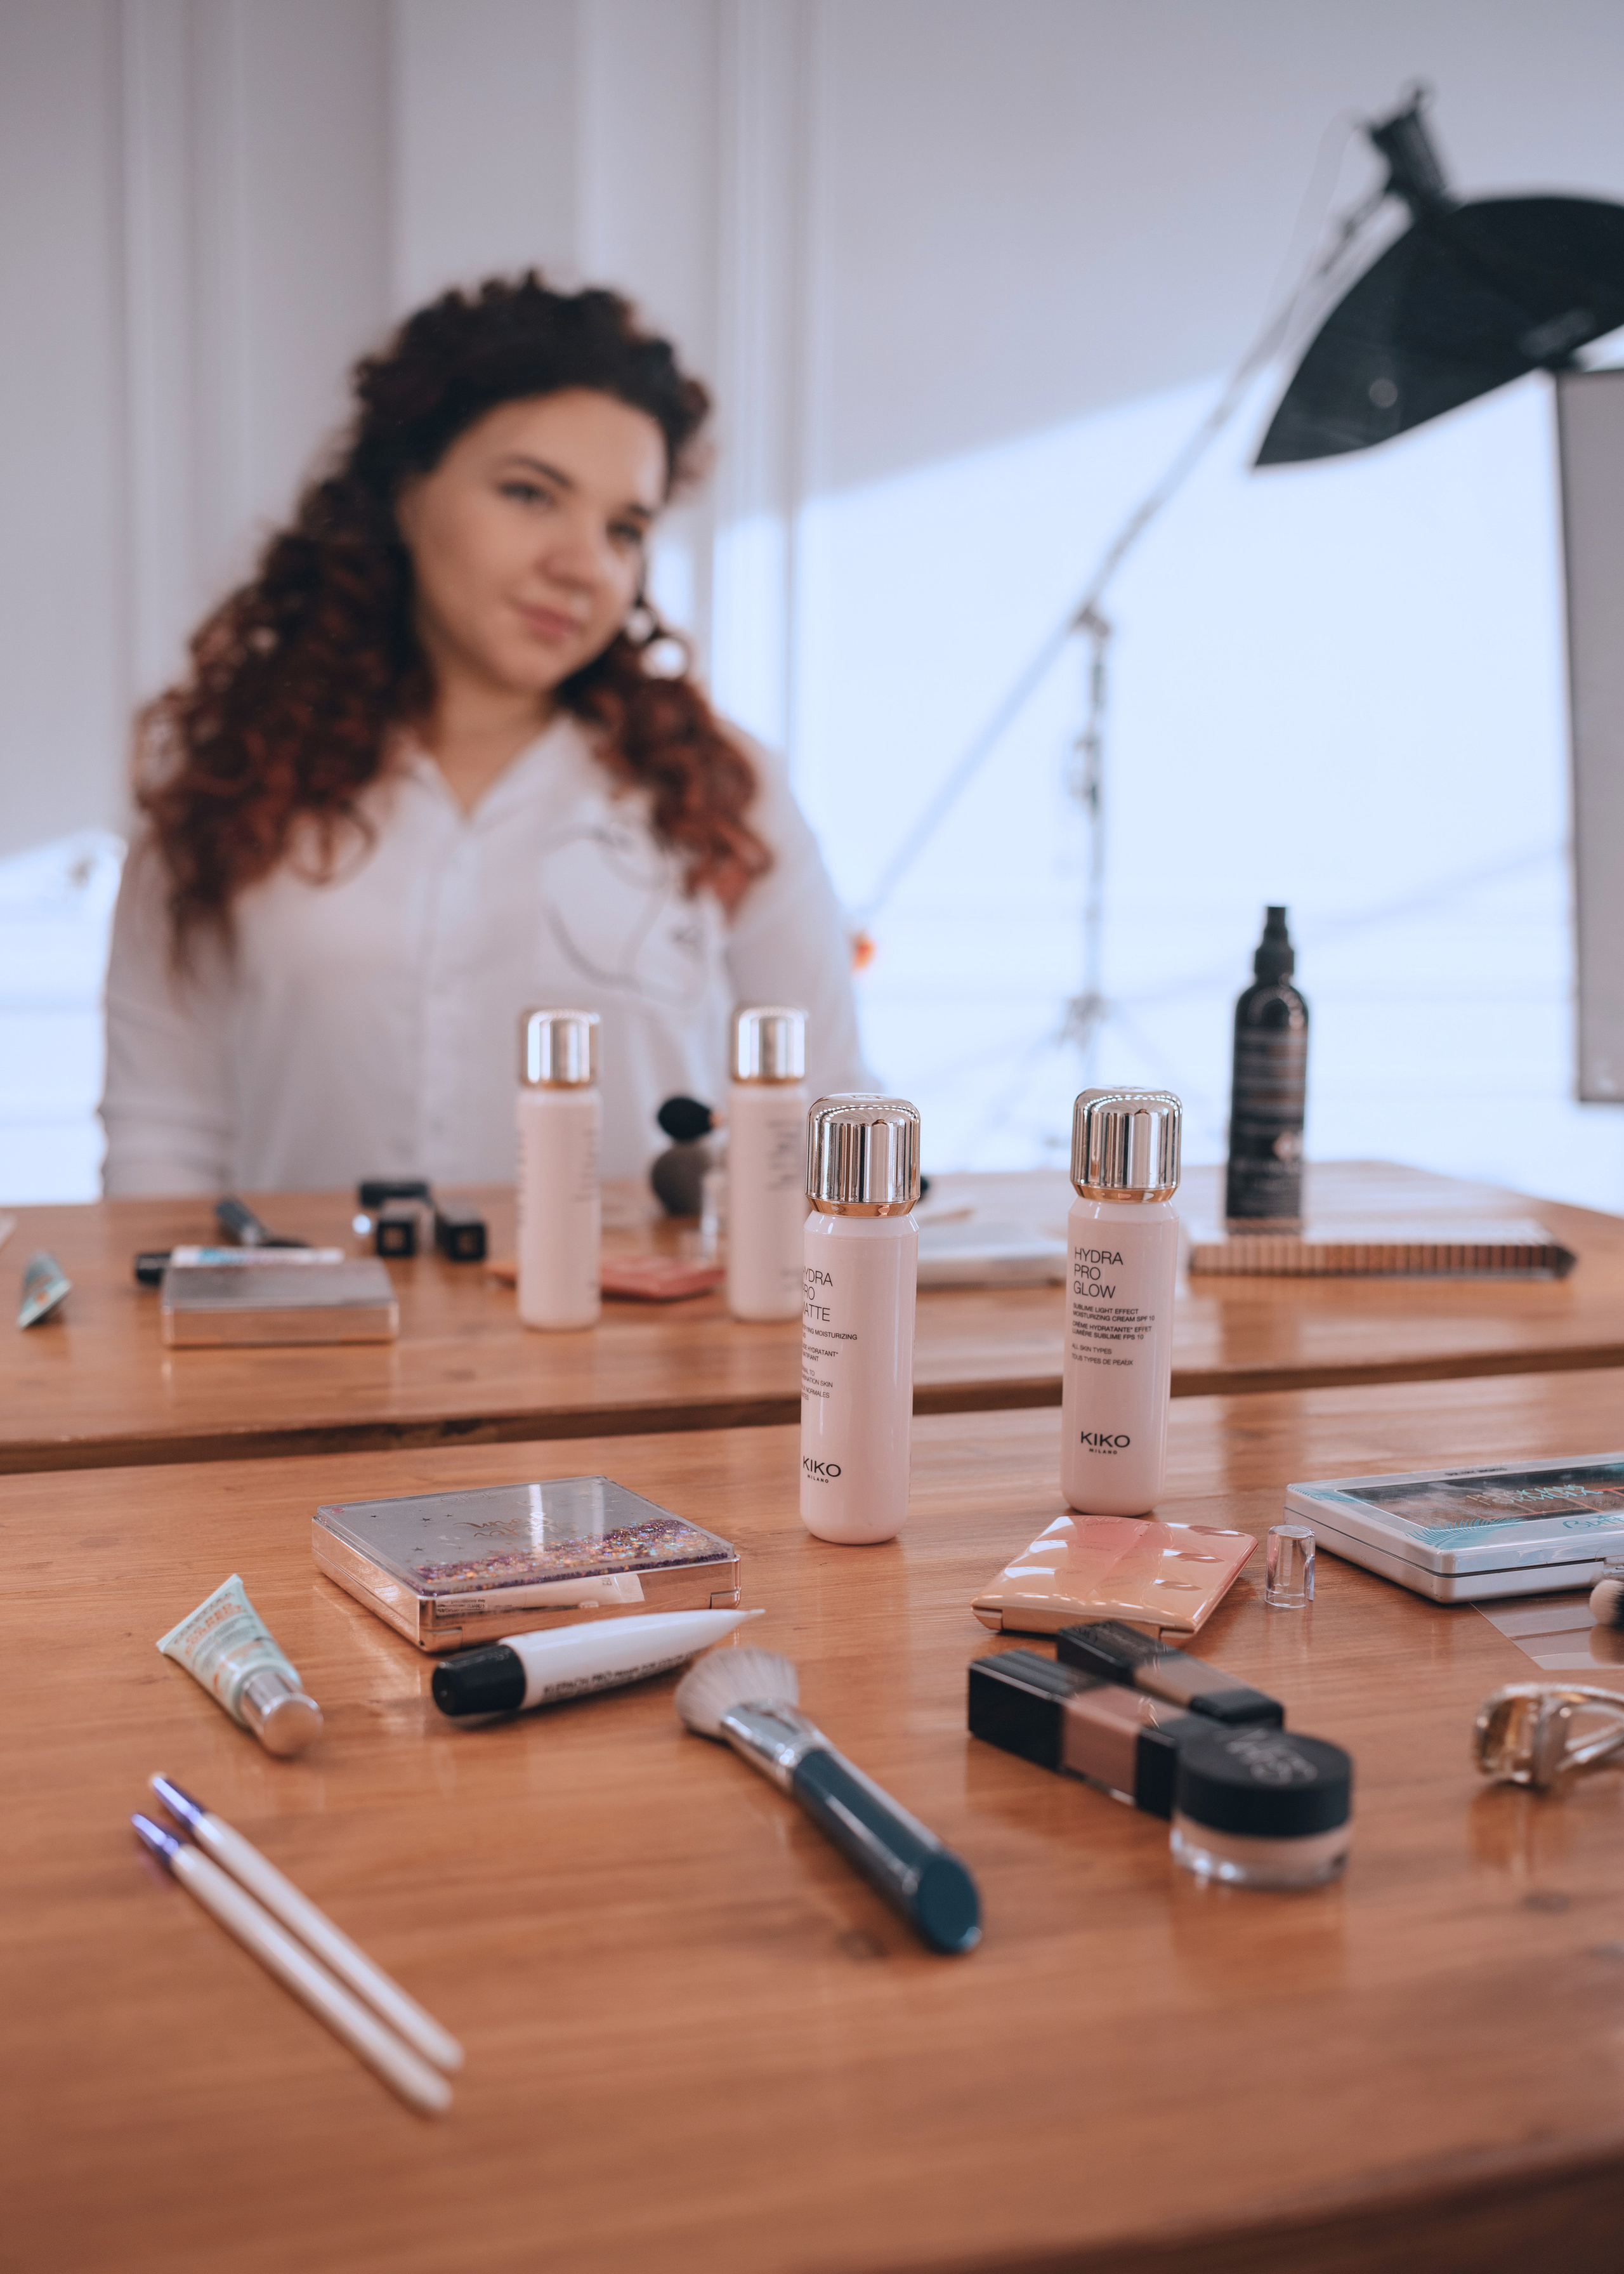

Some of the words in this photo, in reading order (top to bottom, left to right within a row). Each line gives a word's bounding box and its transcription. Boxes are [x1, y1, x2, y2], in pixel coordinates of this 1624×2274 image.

[1075, 1247, 1123, 1265] HYDRA
[1074, 1263, 1101, 1280] PRO
[802, 1284, 815, 1301] RO
[1073, 1280, 1116, 1299] GLOW
[1073, 1302, 1094, 1312] SUBLIME
[1073, 1310, 1111, 1322] MOISTURIZING
[815, 1329, 858, 1341] MOISTURIZING
[1093, 1332, 1122, 1340] SUBLIME
[1093, 1346, 1112, 1355] TYPES
[1084, 1355, 1101, 1364] TYPES
[820, 1380, 833, 1388] SKIN
[1080, 1431, 1130, 1448] KIKO
[802, 1456, 842, 1477] KIKO
[807, 1473, 829, 1483] MILANO
